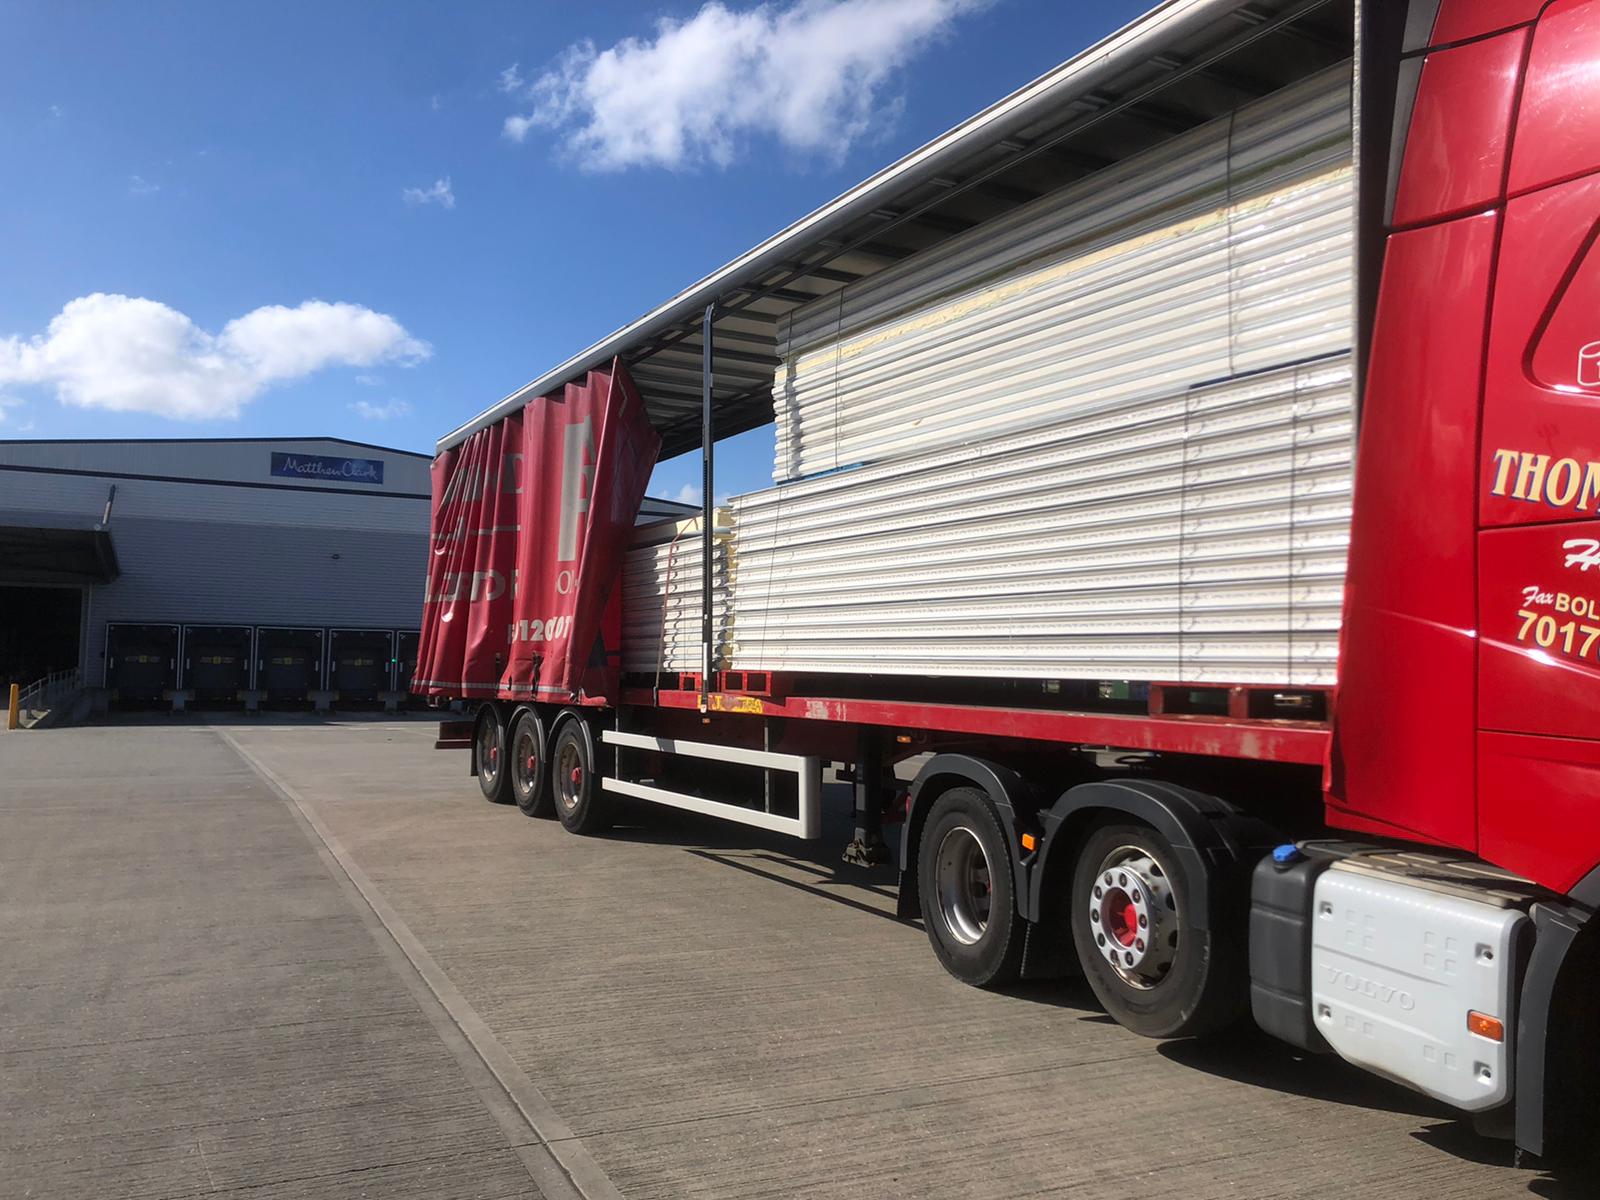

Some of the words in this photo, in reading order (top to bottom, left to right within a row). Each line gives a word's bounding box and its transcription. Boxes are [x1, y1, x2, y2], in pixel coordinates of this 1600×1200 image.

[283, 456, 341, 477] Matthew
[342, 460, 379, 480] Clark
[1521, 585, 1554, 607] Fax
[1555, 592, 1600, 621] BOL
[1319, 962, 1416, 1011] VOLVO
